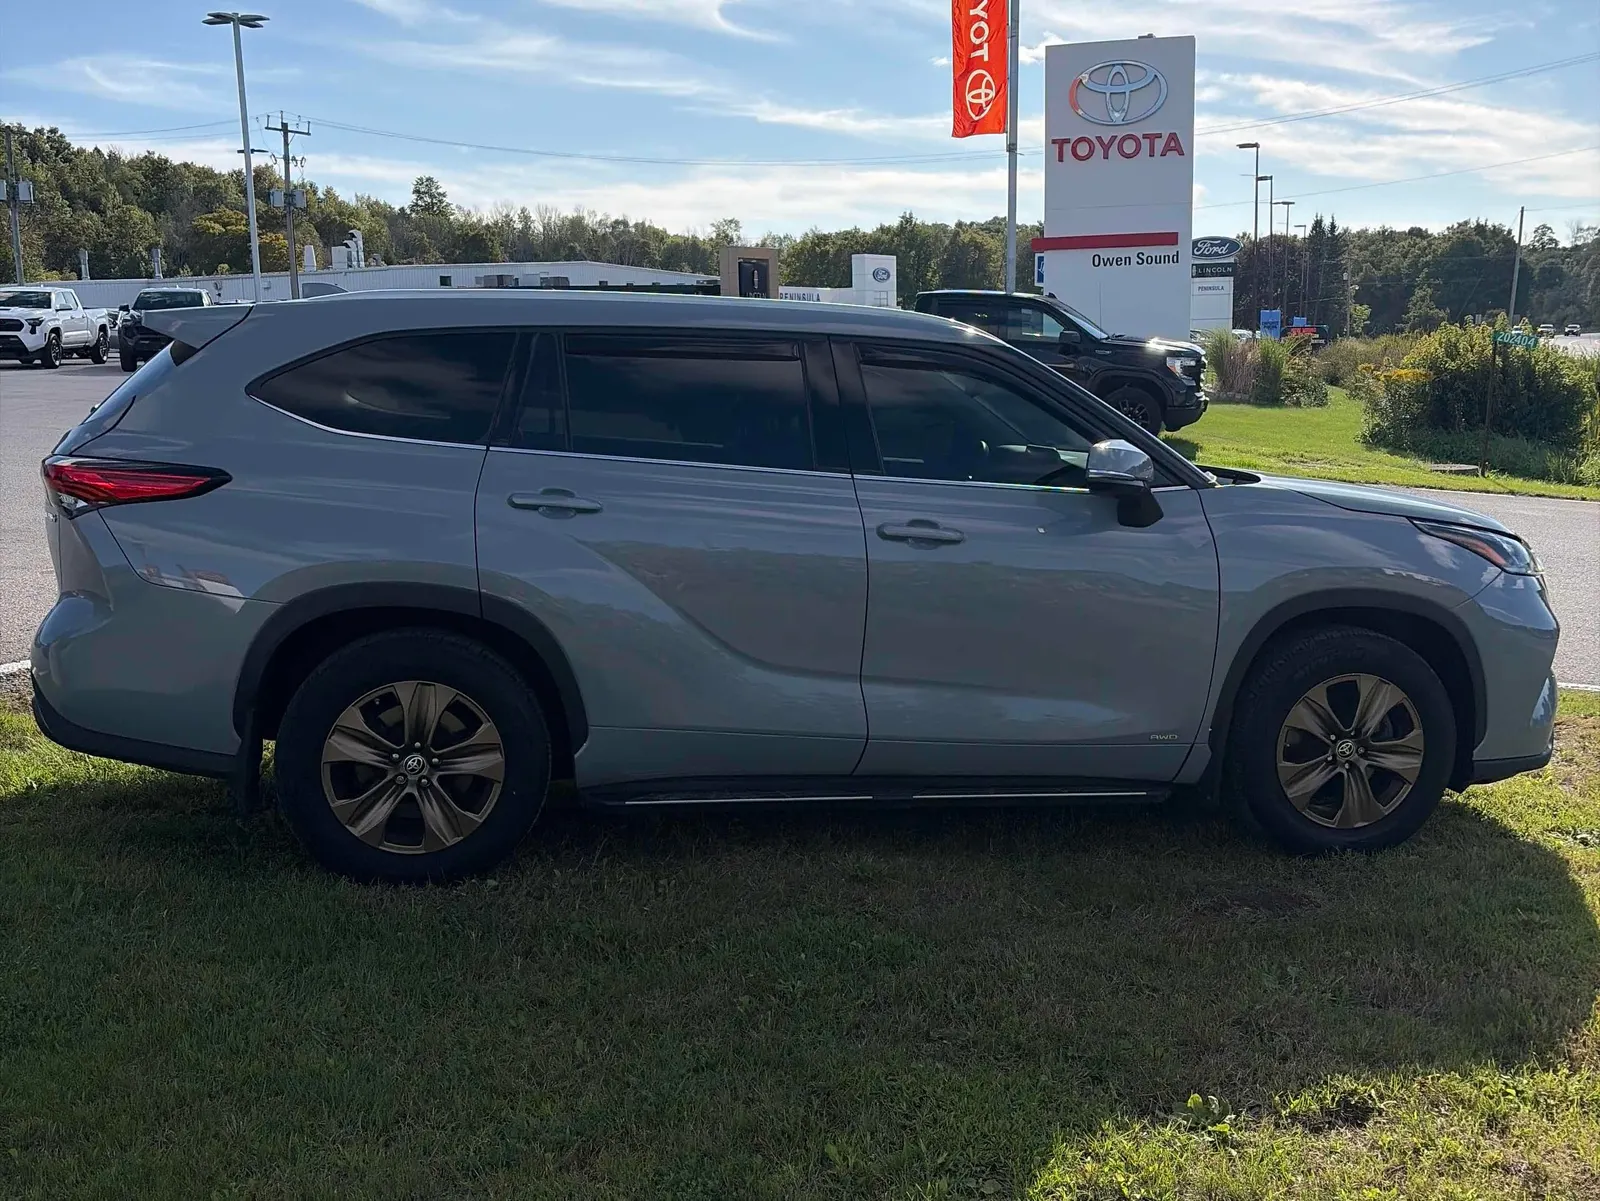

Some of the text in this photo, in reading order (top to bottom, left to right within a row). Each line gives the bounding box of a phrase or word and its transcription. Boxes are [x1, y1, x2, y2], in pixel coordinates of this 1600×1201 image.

[1051, 132, 1185, 163] TOYOTA
[1194, 240, 1230, 255] Ford
[1091, 251, 1180, 268] Owen Sound
[1198, 266, 1233, 274] LINCOLN
[779, 292, 821, 302] PENINSULA
[1497, 331, 1536, 347] 202404
